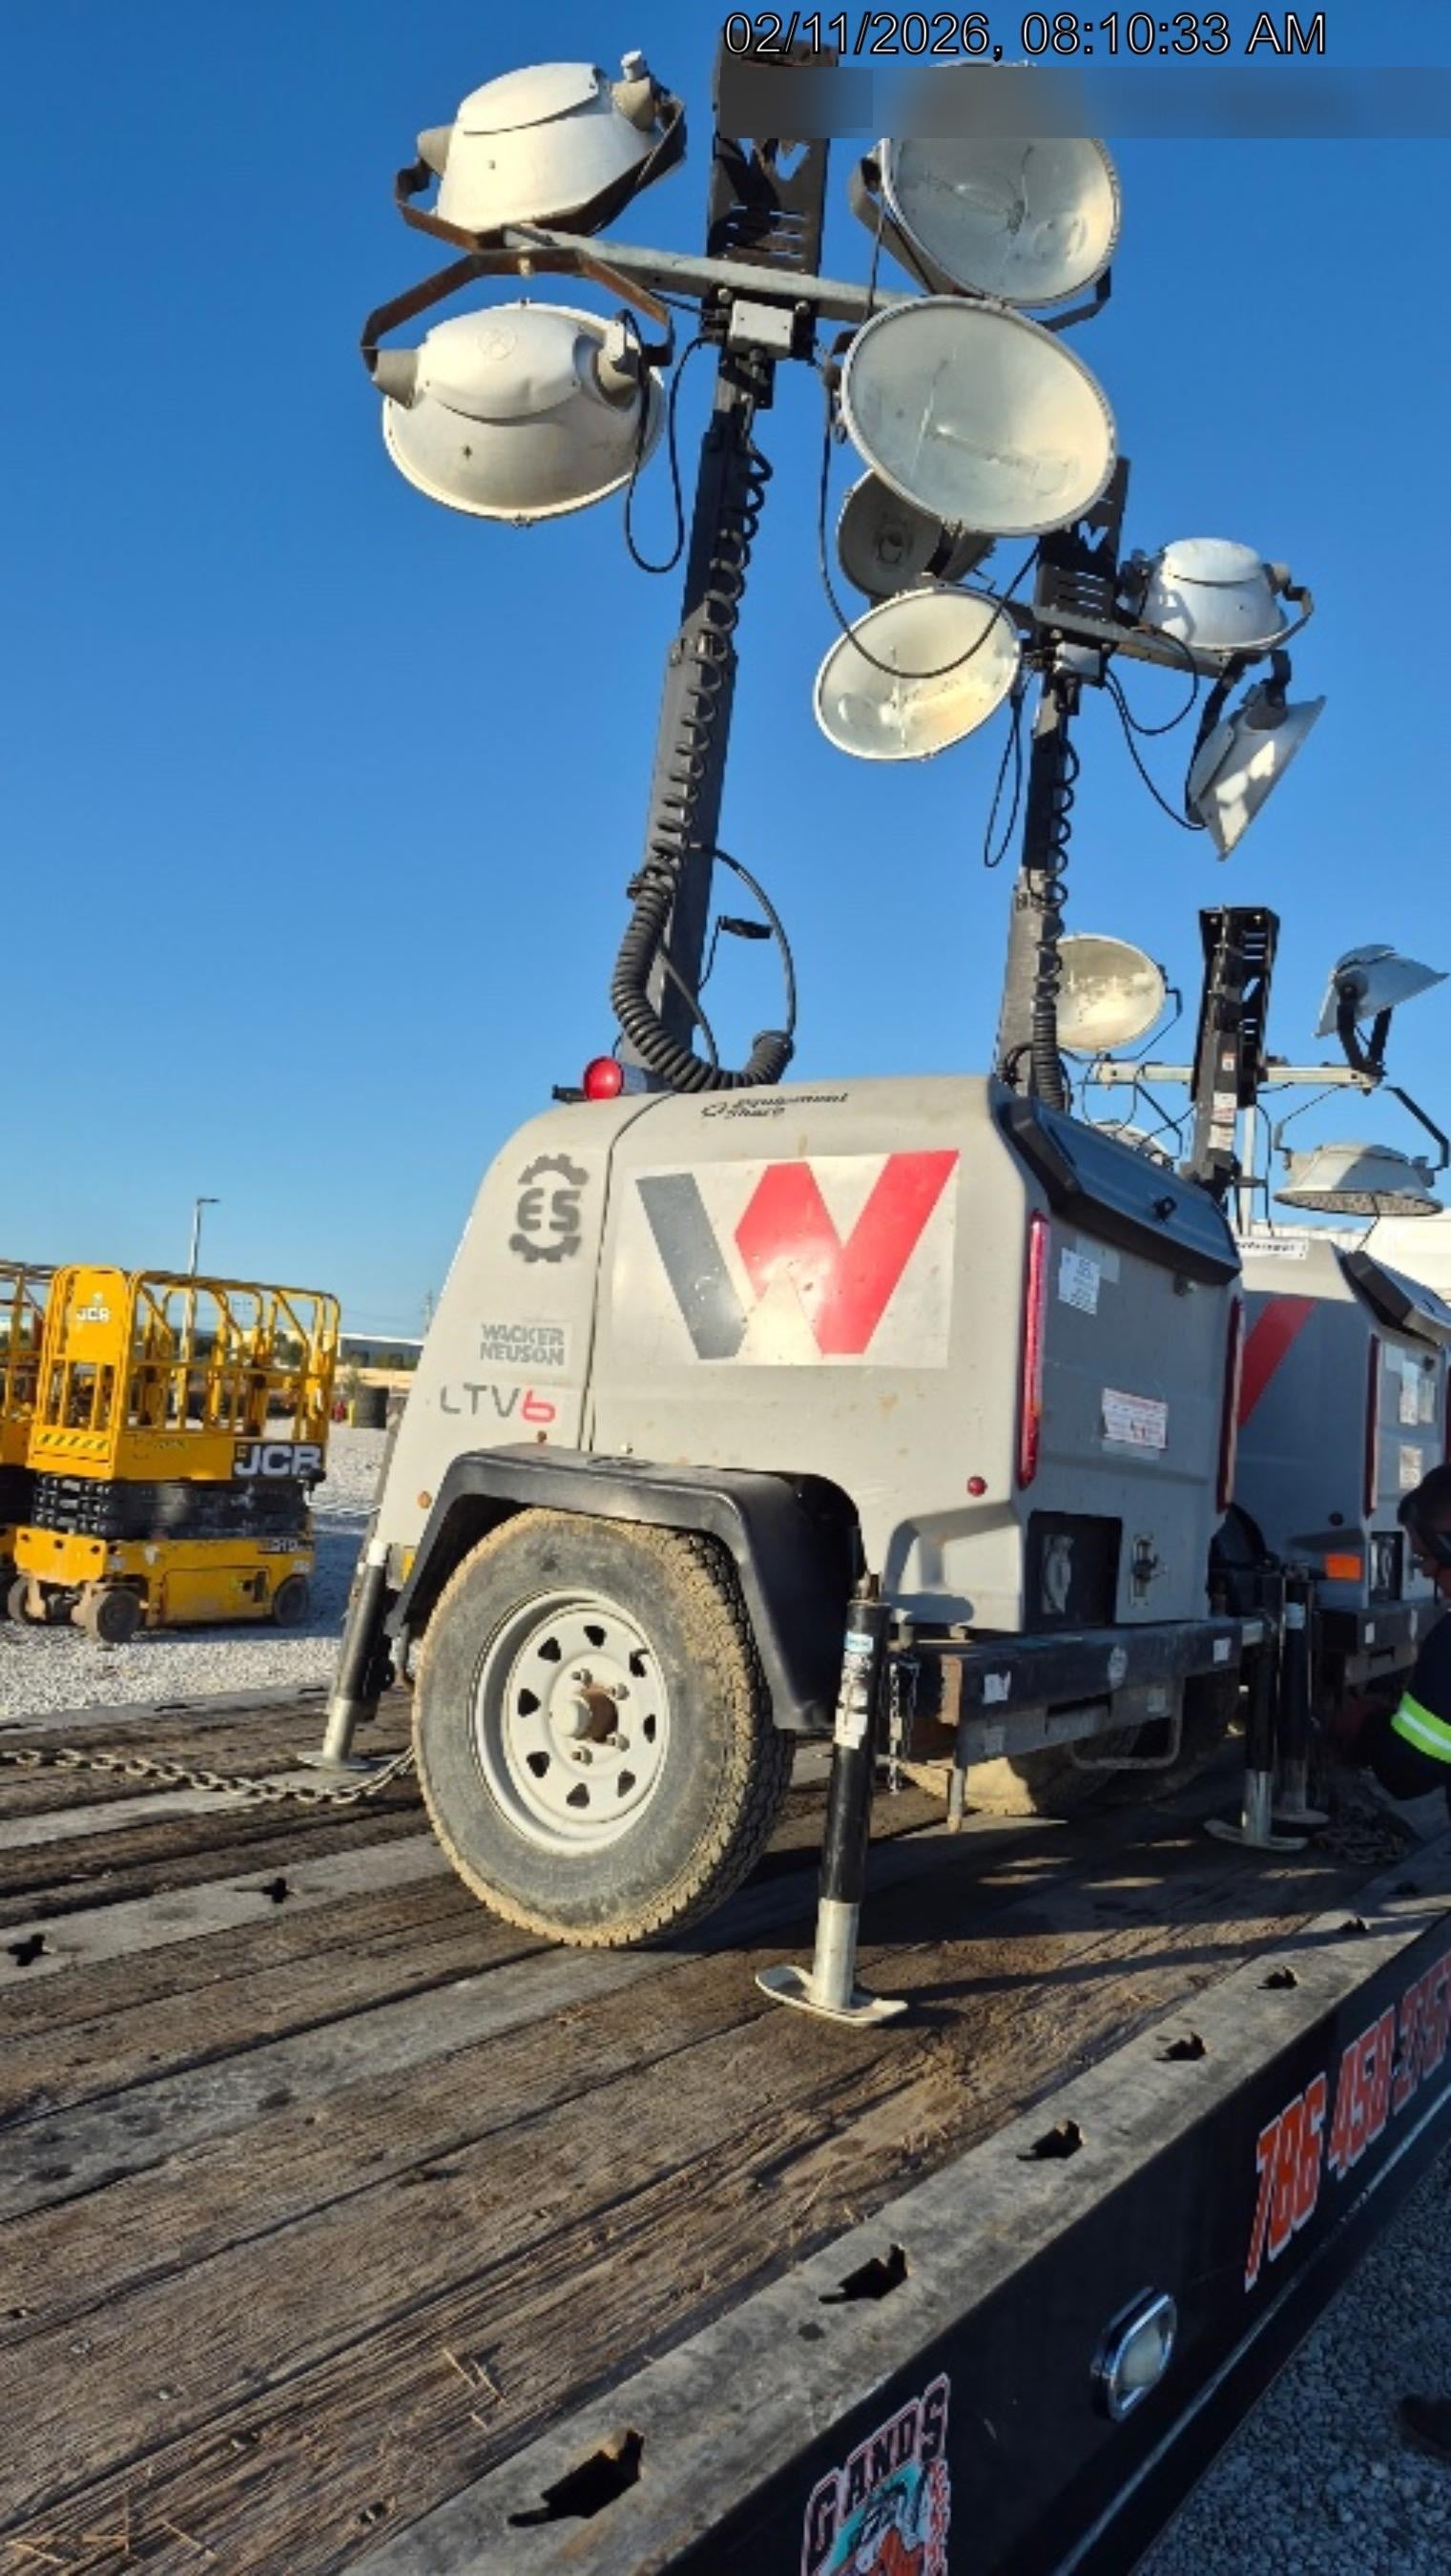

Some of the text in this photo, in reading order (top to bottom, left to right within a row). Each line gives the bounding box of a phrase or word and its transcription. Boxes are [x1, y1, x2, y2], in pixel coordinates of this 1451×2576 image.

[516, 1187, 582, 1232] ES
[481, 1322, 566, 1346] WACKER
[479, 1341, 566, 1367] NEUSON
[439, 1382, 556, 1423] LTV6
[234, 1444, 322, 1476] JCB
[1244, 2071, 1327, 2293] 786
